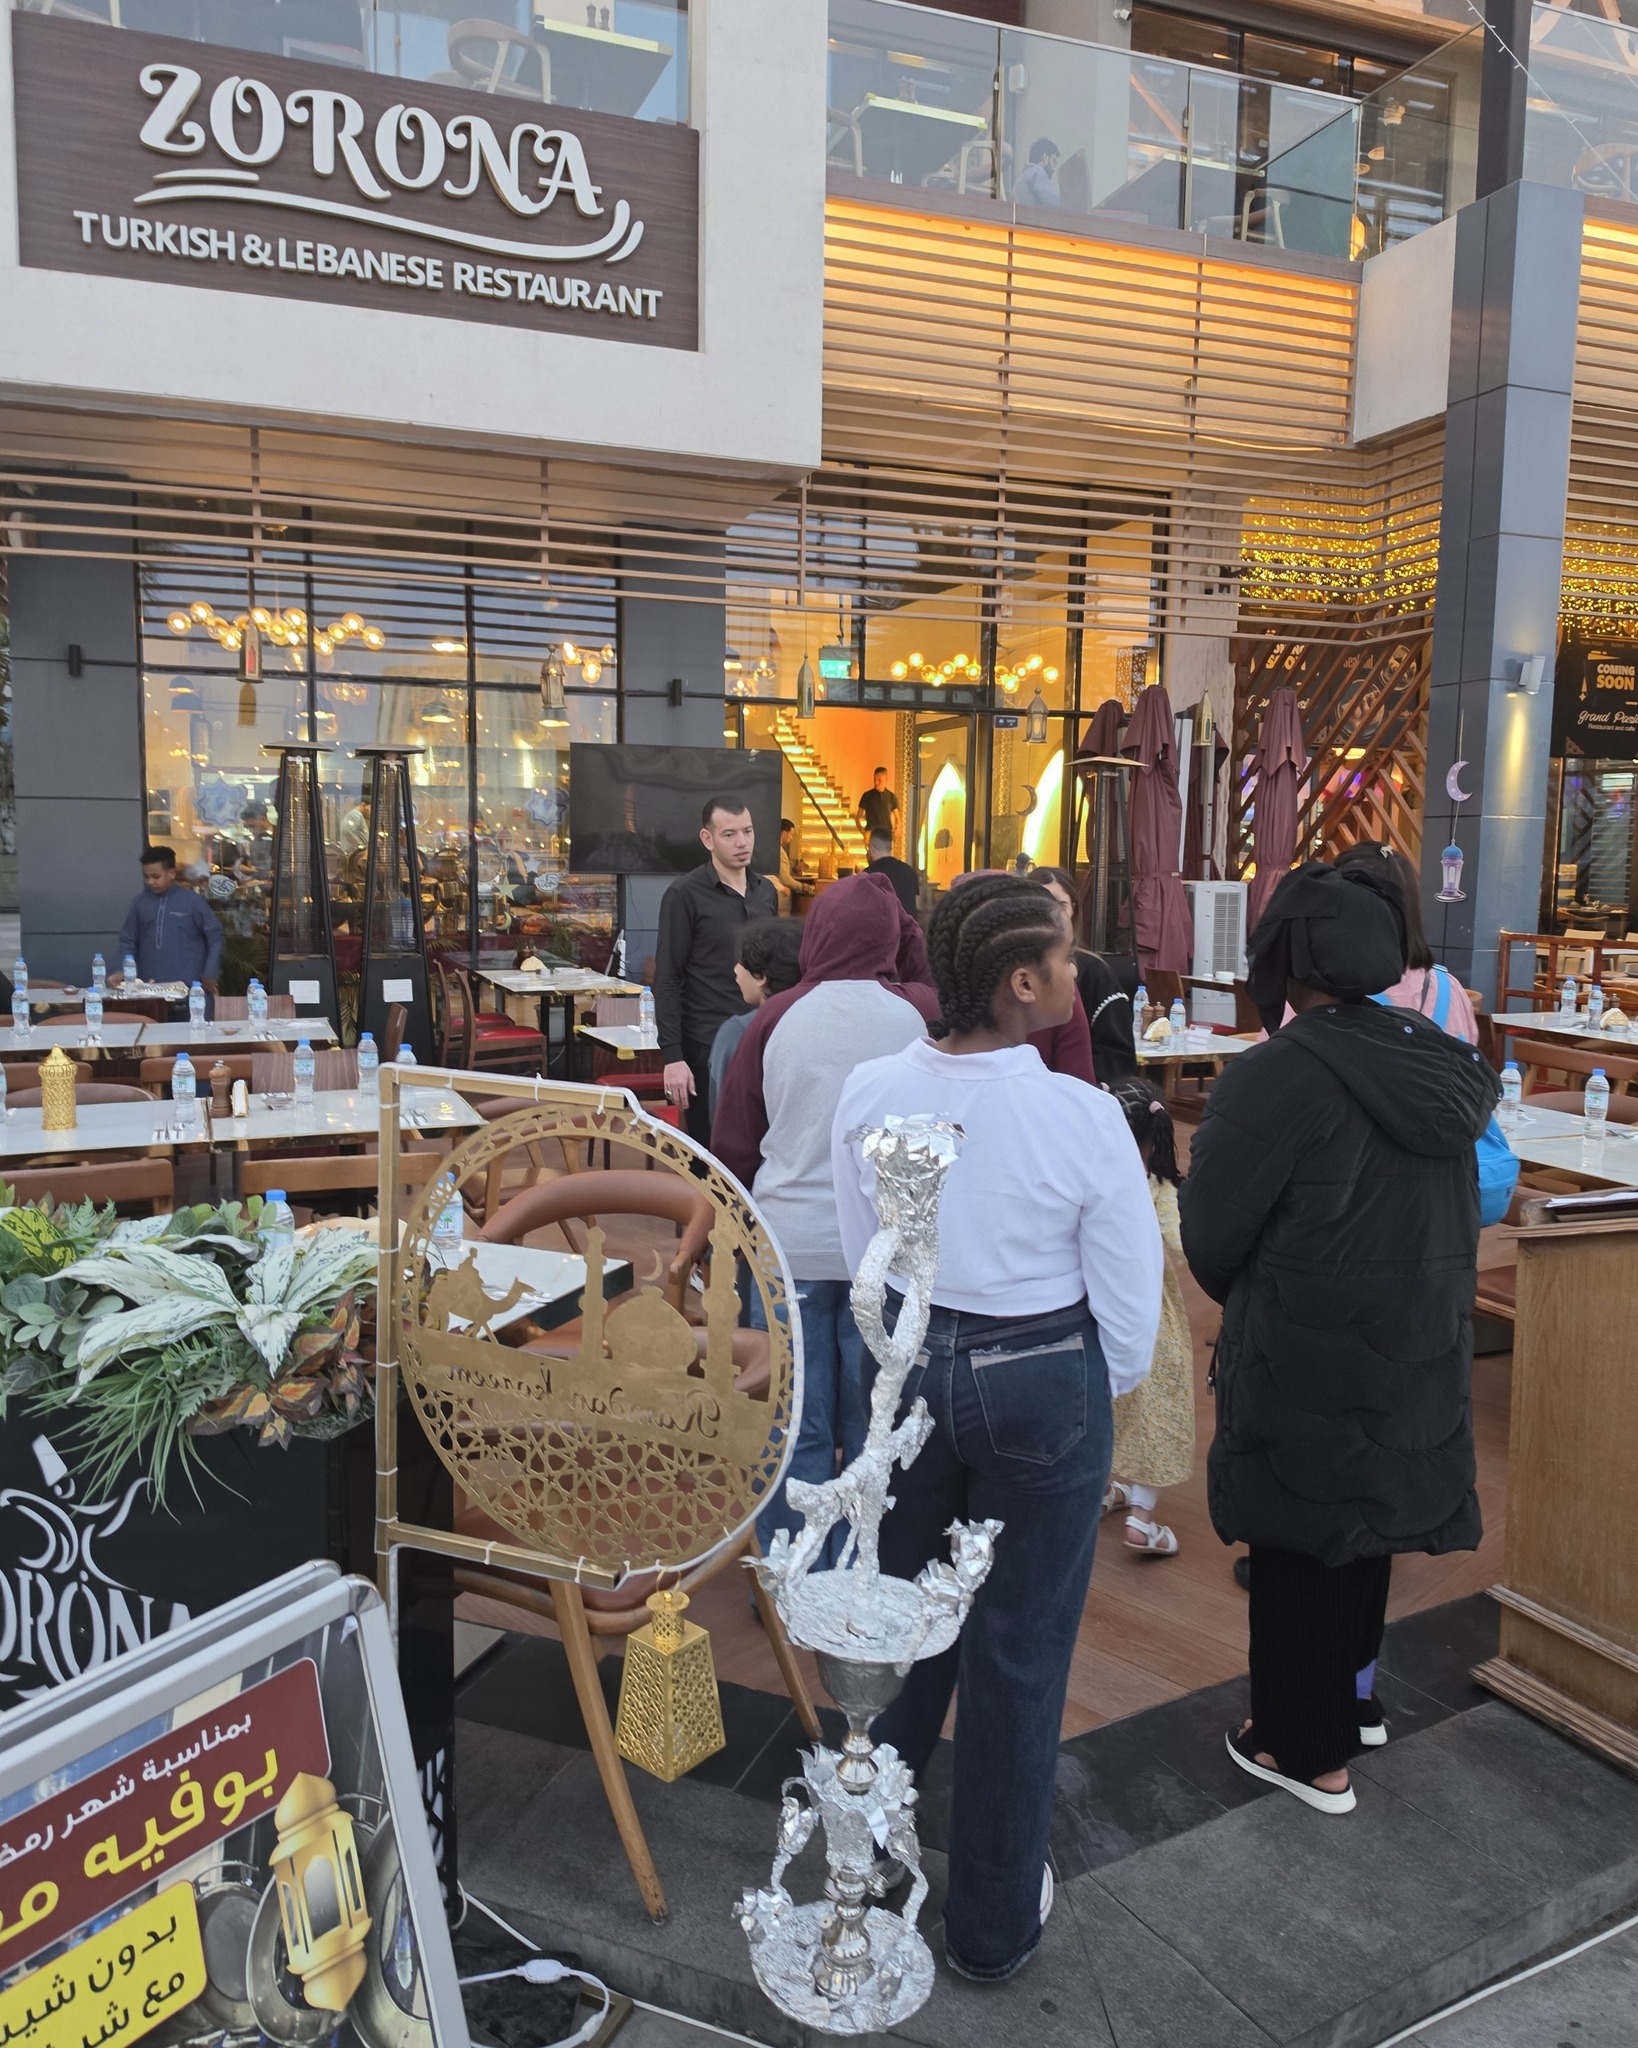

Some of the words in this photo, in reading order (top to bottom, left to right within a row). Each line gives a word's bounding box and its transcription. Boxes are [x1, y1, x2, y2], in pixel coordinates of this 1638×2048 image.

[139, 63, 605, 218] ZORONA
[73, 210, 236, 262] TURKISH
[241, 233, 275, 268] &
[278, 238, 444, 290] LEBANESE
[453, 261, 663, 320] RESTAURANT
[1596, 675, 1635, 691] SOON
[1597, 664, 1635, 676] COMING
[142, 1713, 252, 1783] بمناسبة
[61, 1774, 136, 1839] شهر
[84, 1748, 279, 1879] بوفيه
[88, 1914, 178, 1993] بدون
[142, 1972, 185, 2019] مع
